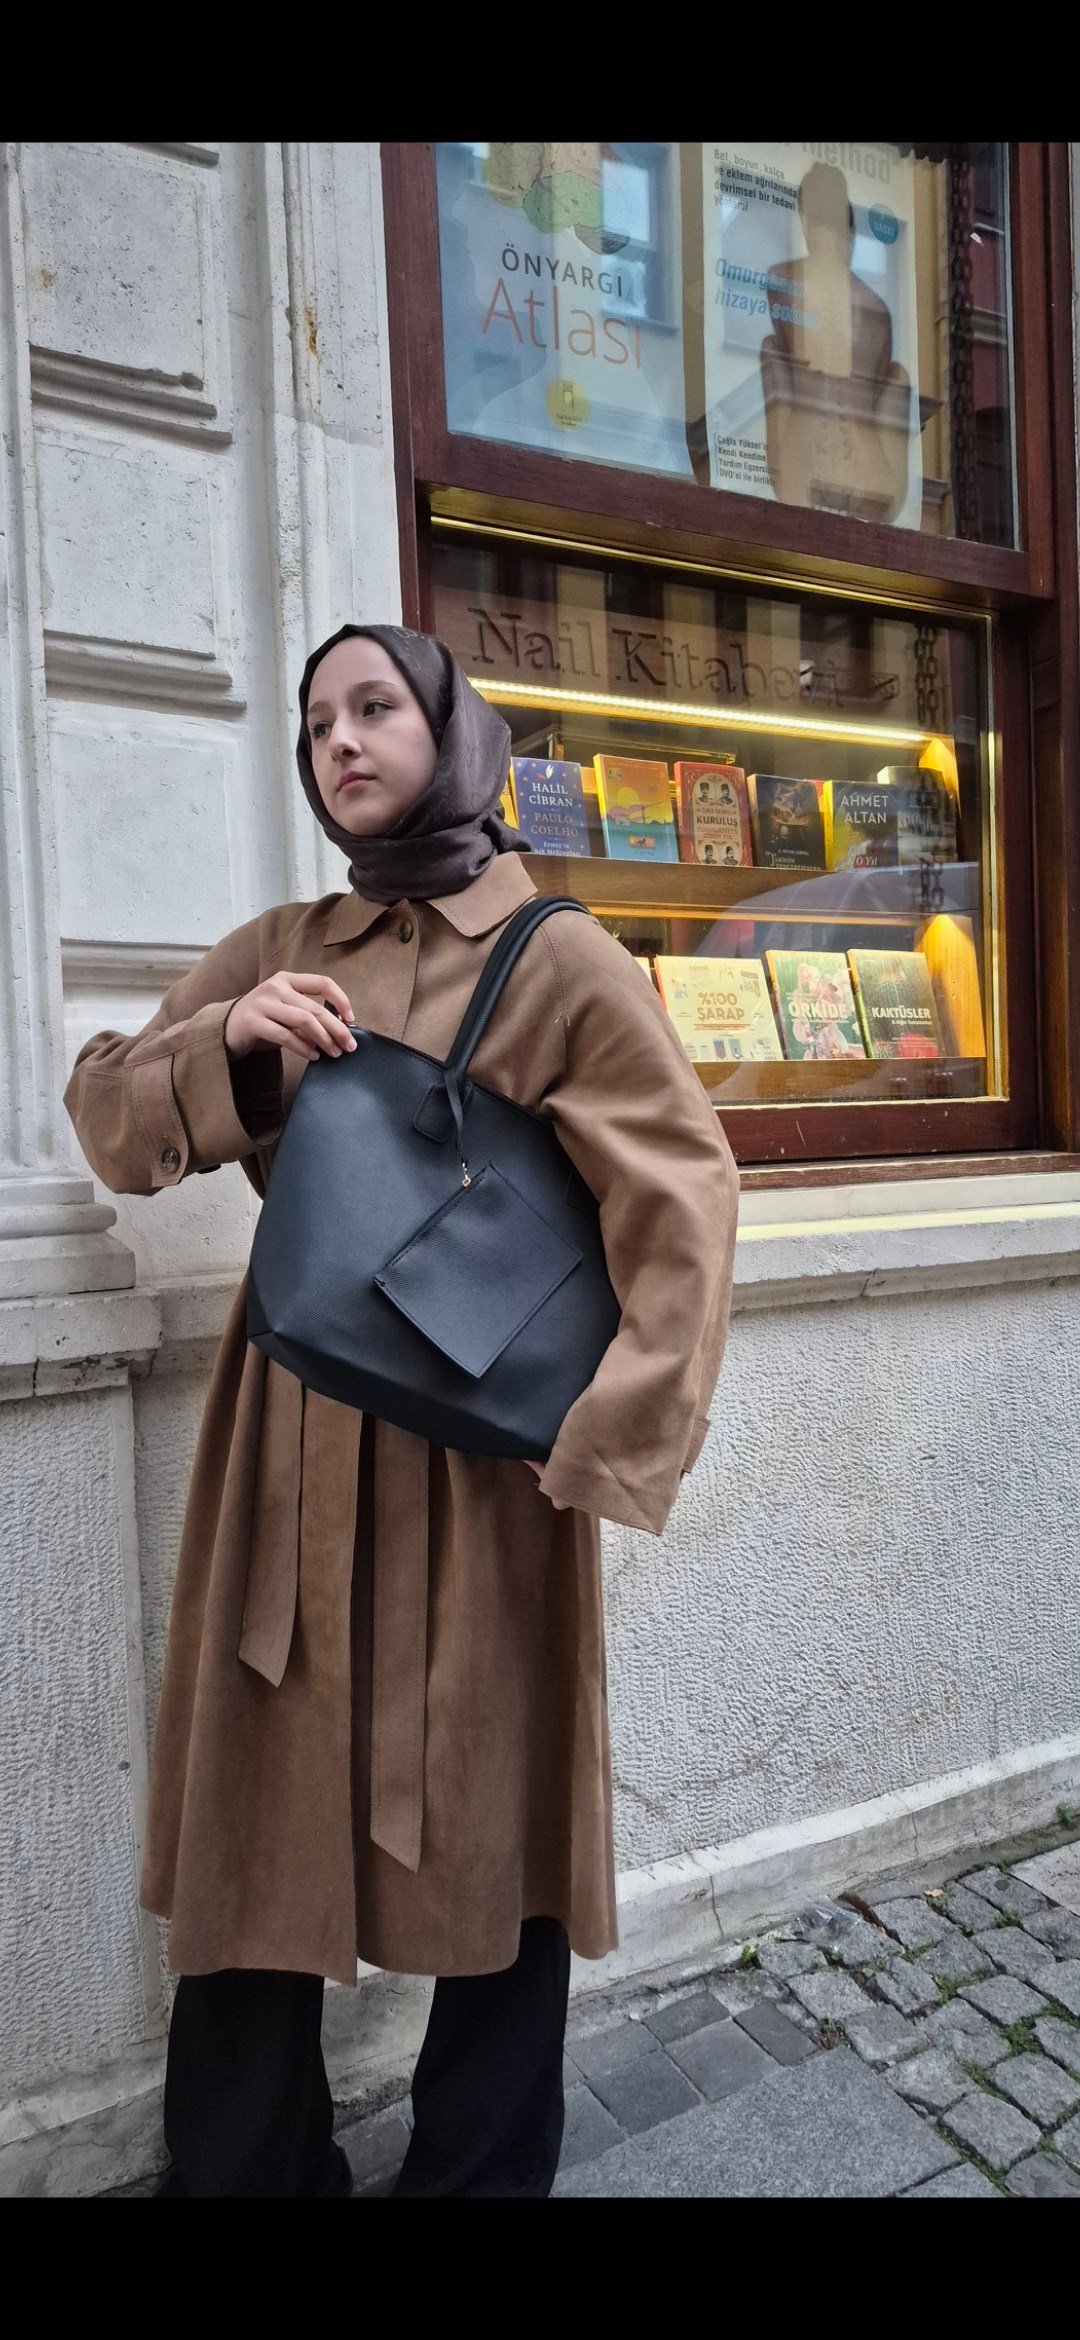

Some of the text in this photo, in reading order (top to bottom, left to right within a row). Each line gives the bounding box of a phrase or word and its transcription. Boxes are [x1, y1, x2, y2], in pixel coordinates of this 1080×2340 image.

[714, 148, 731, 164] Bel,
[764, 163, 785, 180] kalça
[714, 166, 798, 199] ve eklem ağrılarında
[714, 180, 796, 211] devrimsel bir tedavi
[502, 242, 622, 298] ÖNYARGI
[715, 286, 767, 316] hizaya
[482, 277, 641, 369] Atlası
[717, 435, 737, 447] Çağla
[718, 446, 767, 462] Kendi Kendine
[718, 457, 742, 469] Yardım
[743, 472, 752, 482] ile
[467, 607, 843, 709] Nail Kitabevi
[532, 782, 568, 795] HALİL
[529, 794, 573, 807] CİBRAN
[840, 795, 889, 808] AHMET
[534, 812, 573, 824] PAULO
[696, 815, 738, 828] KURULUŞ
[844, 811, 887, 824] ALTAN
[530, 824, 579, 837] COELHO
[856, 856, 864, 866] O
[698, 991, 738, 1006] %100
[872, 1005, 932, 1019] KAKTÜSLER
